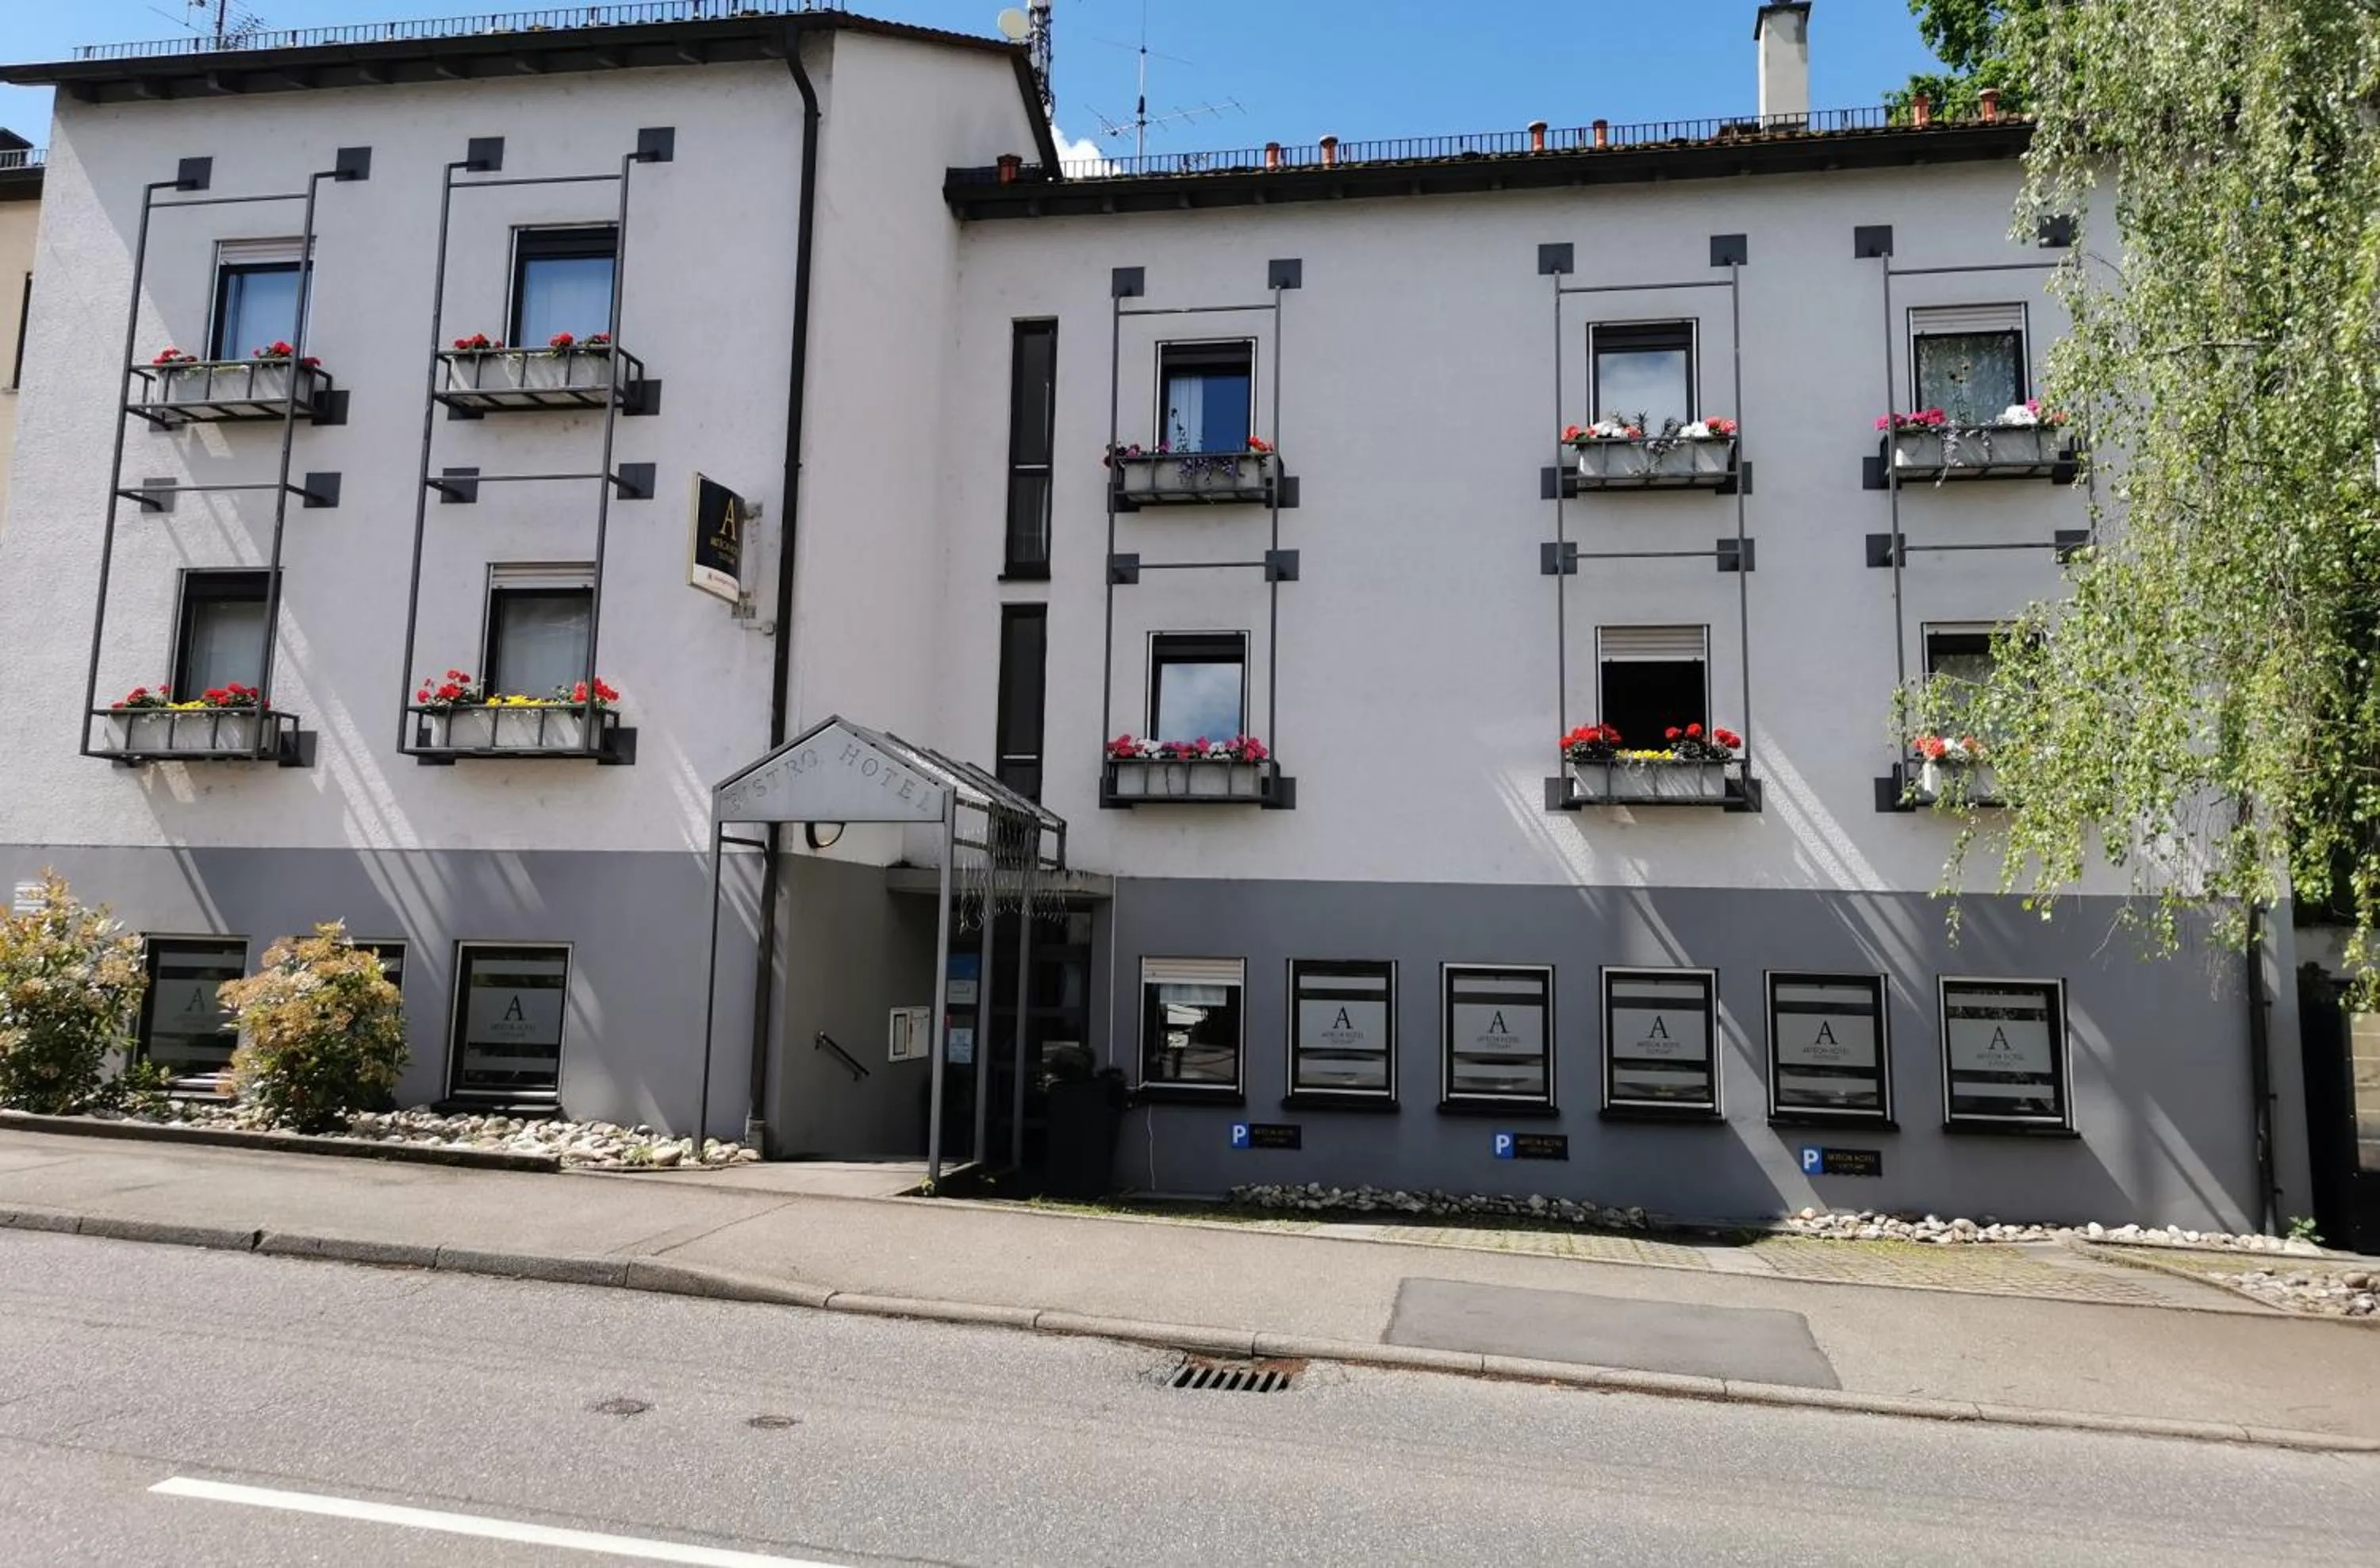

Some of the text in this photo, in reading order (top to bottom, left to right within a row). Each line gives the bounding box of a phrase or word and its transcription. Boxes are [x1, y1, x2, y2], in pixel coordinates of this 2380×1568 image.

[719, 496, 737, 541] A
[839, 744, 931, 812] HOTEL
[185, 986, 205, 1012] A
[503, 994, 527, 1021] A
[1333, 1005, 1353, 1029] A
[1488, 1010, 1510, 1033] A
[1647, 1015, 1670, 1039] A
[1814, 1020, 1839, 1045] A
[1987, 1025, 2011, 1050] A
[1233, 1124, 1246, 1143] P
[1496, 1135, 1510, 1155] P
[1803, 1149, 1818, 1169] P
